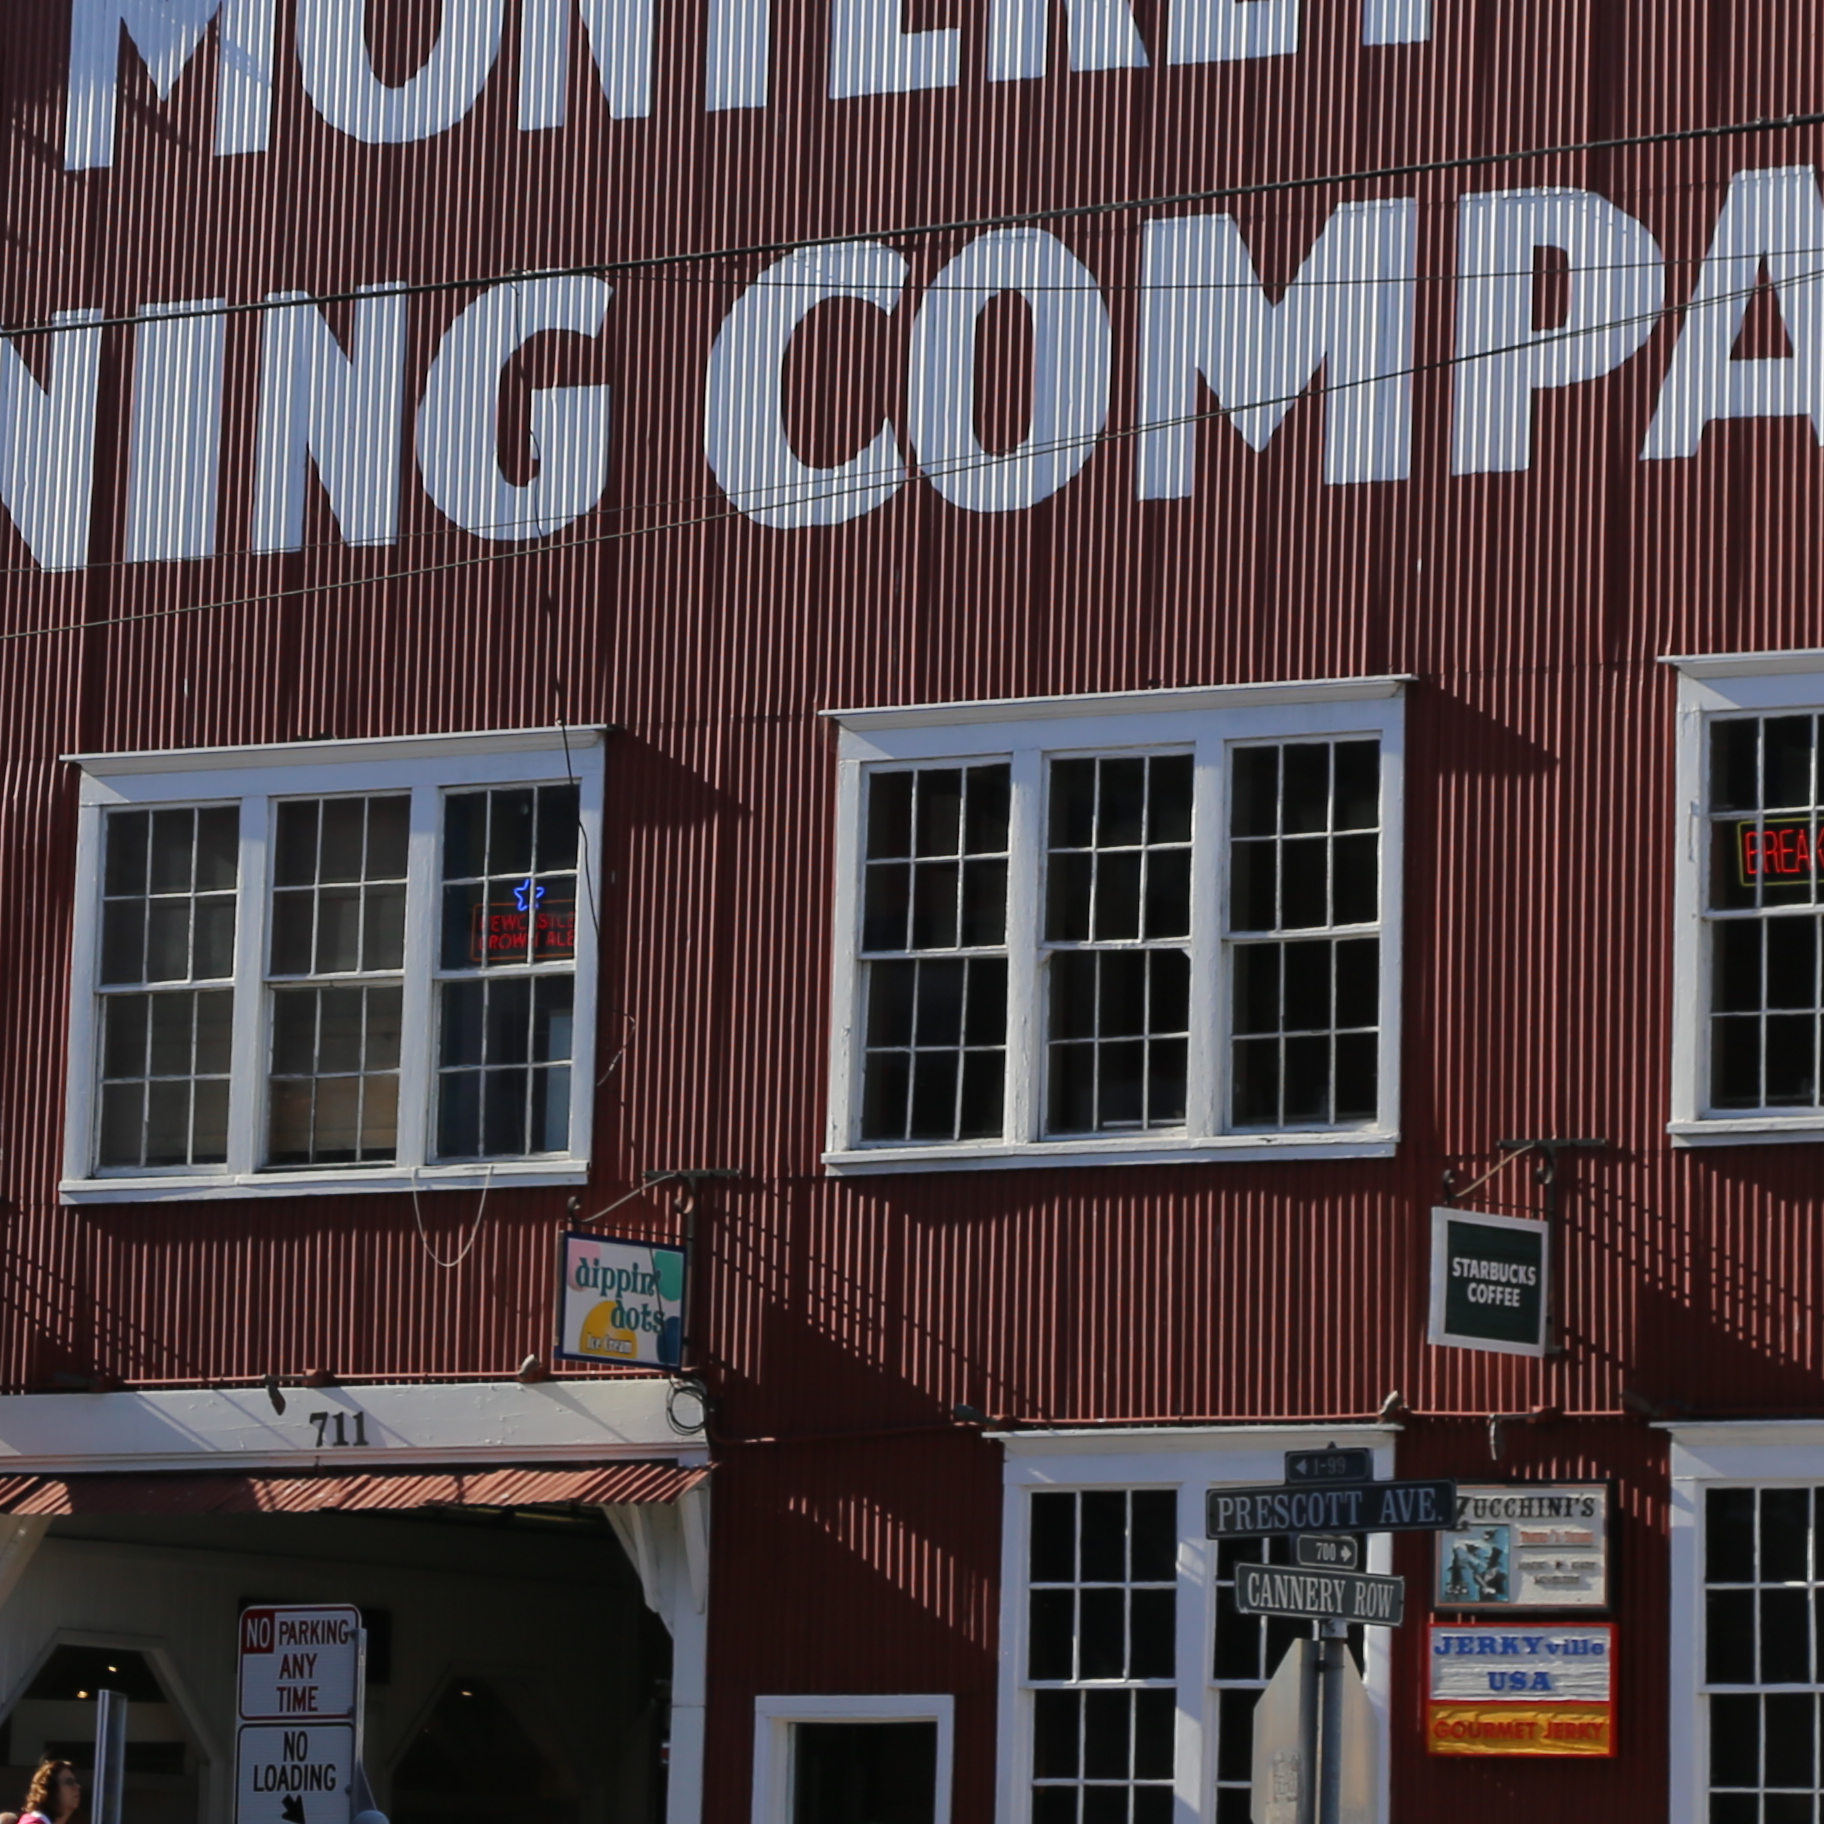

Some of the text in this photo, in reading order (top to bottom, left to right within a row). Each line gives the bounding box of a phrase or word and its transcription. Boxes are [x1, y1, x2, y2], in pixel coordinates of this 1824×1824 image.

[1452, 1257, 1537, 1286] STARBUCKS
[1467, 1282, 1520, 1307] COFFEE
[611, 1299, 665, 1335] dots
[587, 1332, 632, 1354] Ice Cream
[309, 1411, 369, 1448] 711
[1313, 1456, 1346, 1474] 1-99
[1217, 1487, 1443, 1532] PRESCOTT AVE.
[1316, 1541, 1336, 1562] 700
[1248, 1571, 1394, 1618] CANNERY ROW
[246, 1617, 350, 1649] NO PARKING
[279, 1652, 318, 1679] ANY
[1487, 1671, 1553, 1691] USA
[277, 1686, 319, 1713] TIME
[1433, 1719, 1604, 1740] GOURMET JERKY
[283, 1730, 308, 1762] NO
[253, 1764, 336, 1792] LOADING
